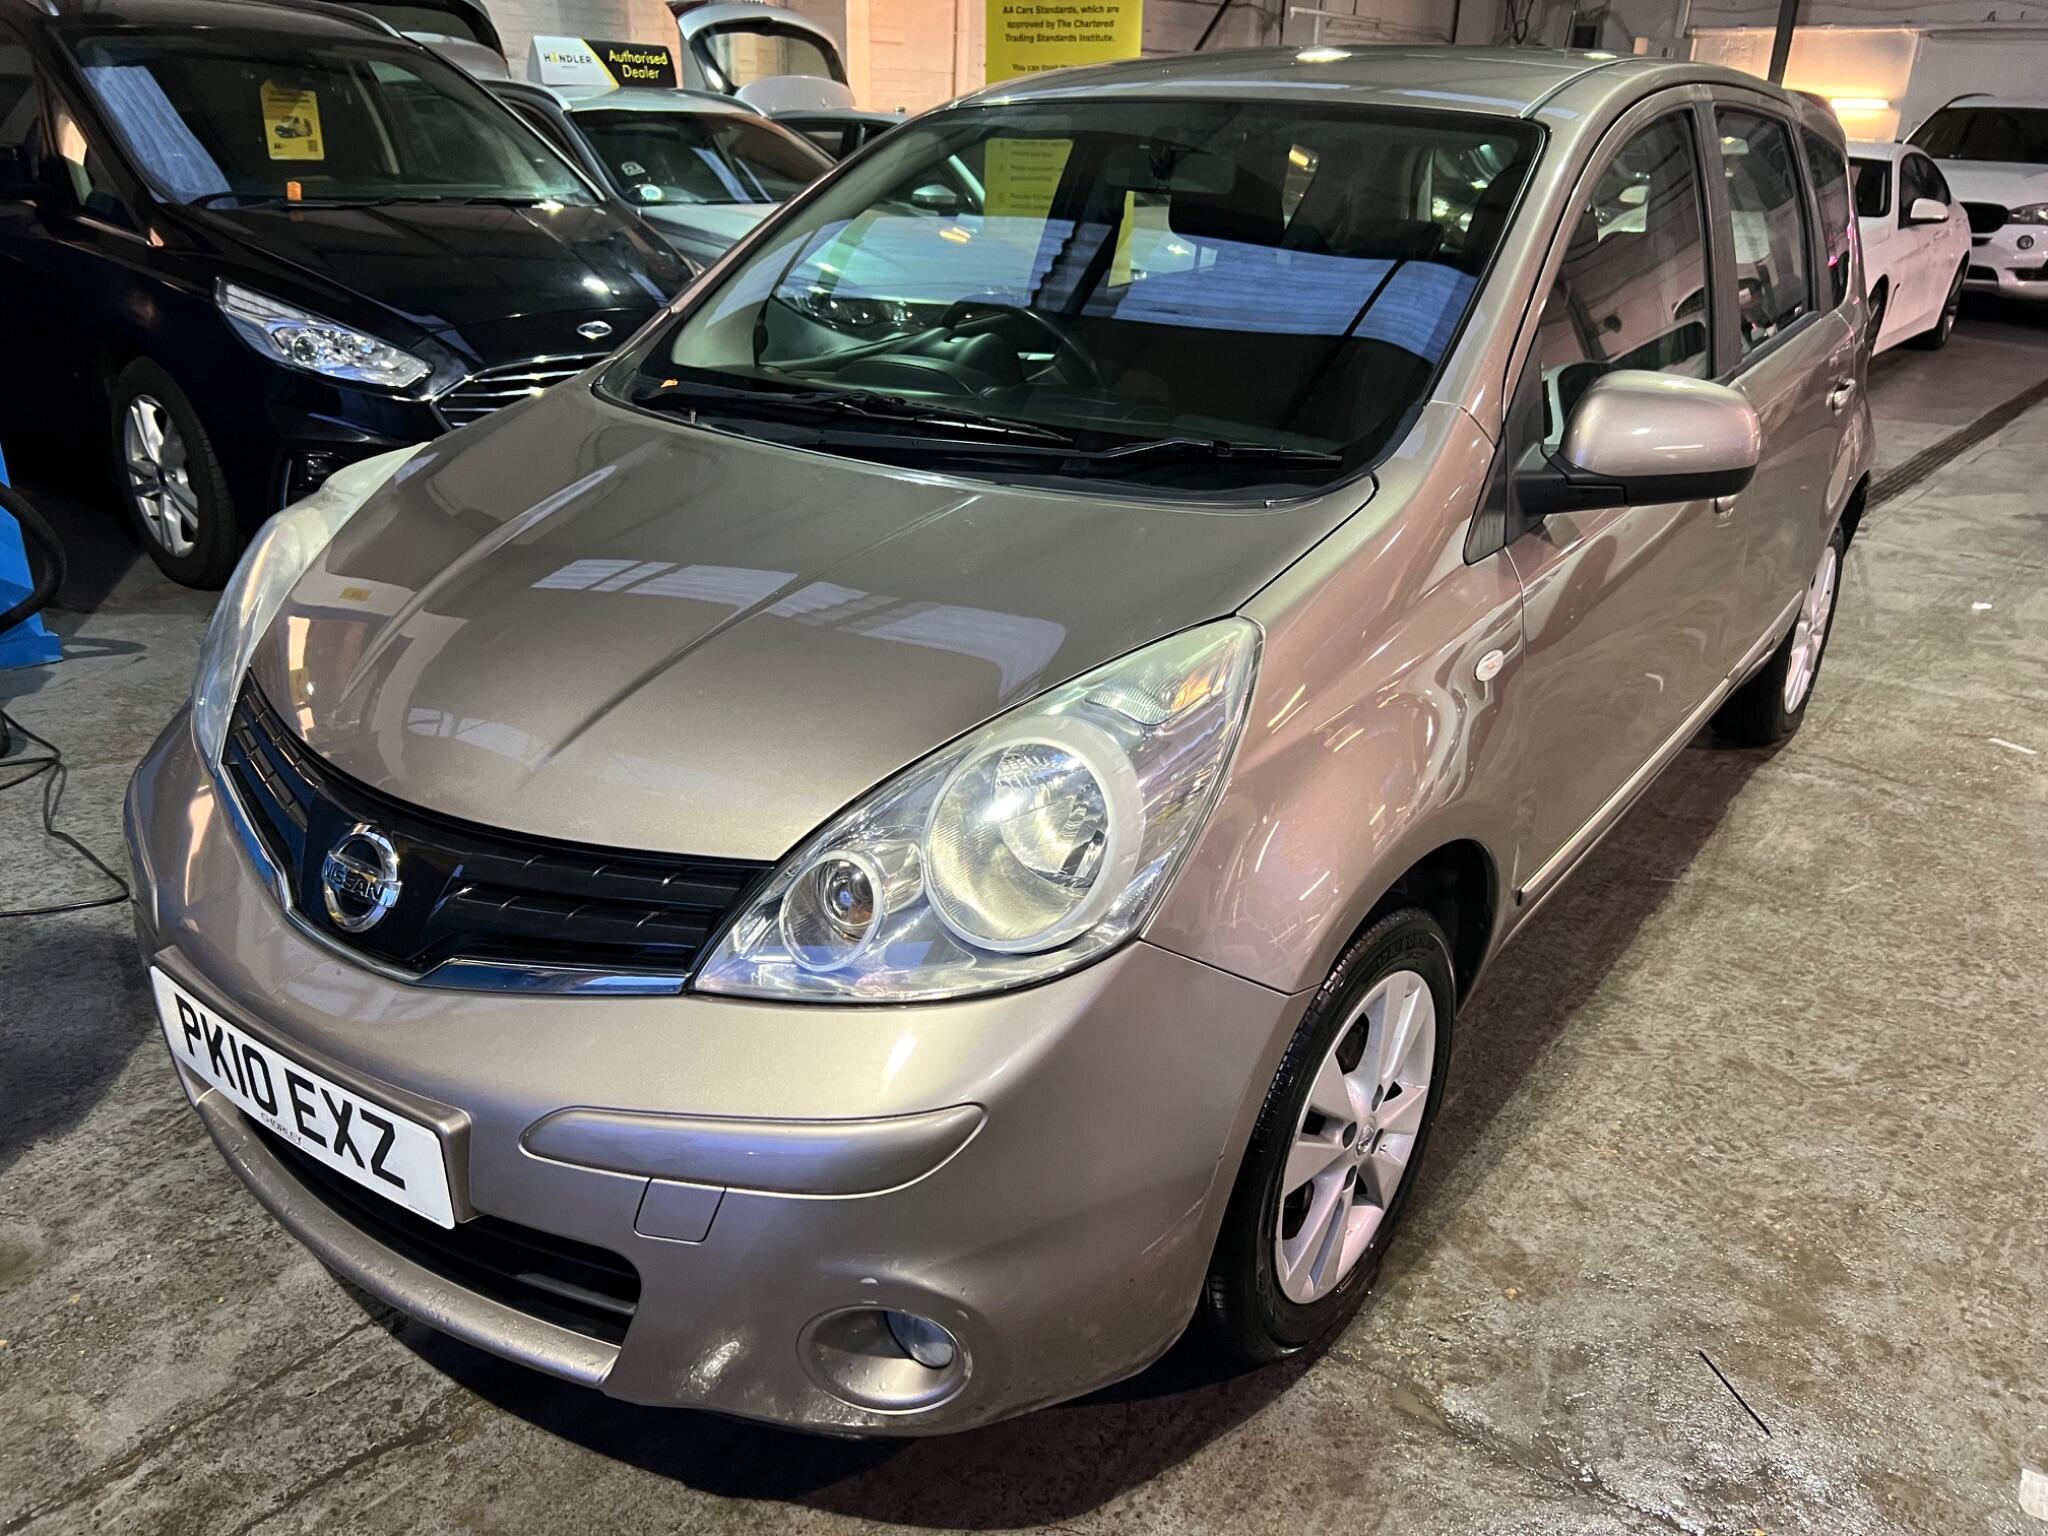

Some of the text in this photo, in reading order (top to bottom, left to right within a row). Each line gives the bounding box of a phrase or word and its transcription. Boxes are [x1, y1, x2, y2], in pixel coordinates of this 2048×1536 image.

[1016, 6, 1033, 14] Cars
[1080, 5, 1104, 14] which
[1007, 19, 1114, 29] approved by The Chartered
[1005, 34, 1034, 43] Trading
[1036, 34, 1077, 42] Standards
[609, 50, 668, 65] Authorised
[622, 65, 660, 79] Dealer
[324, 857, 385, 901] NISSAN
[174, 993, 406, 1191] PK10 EXZ
